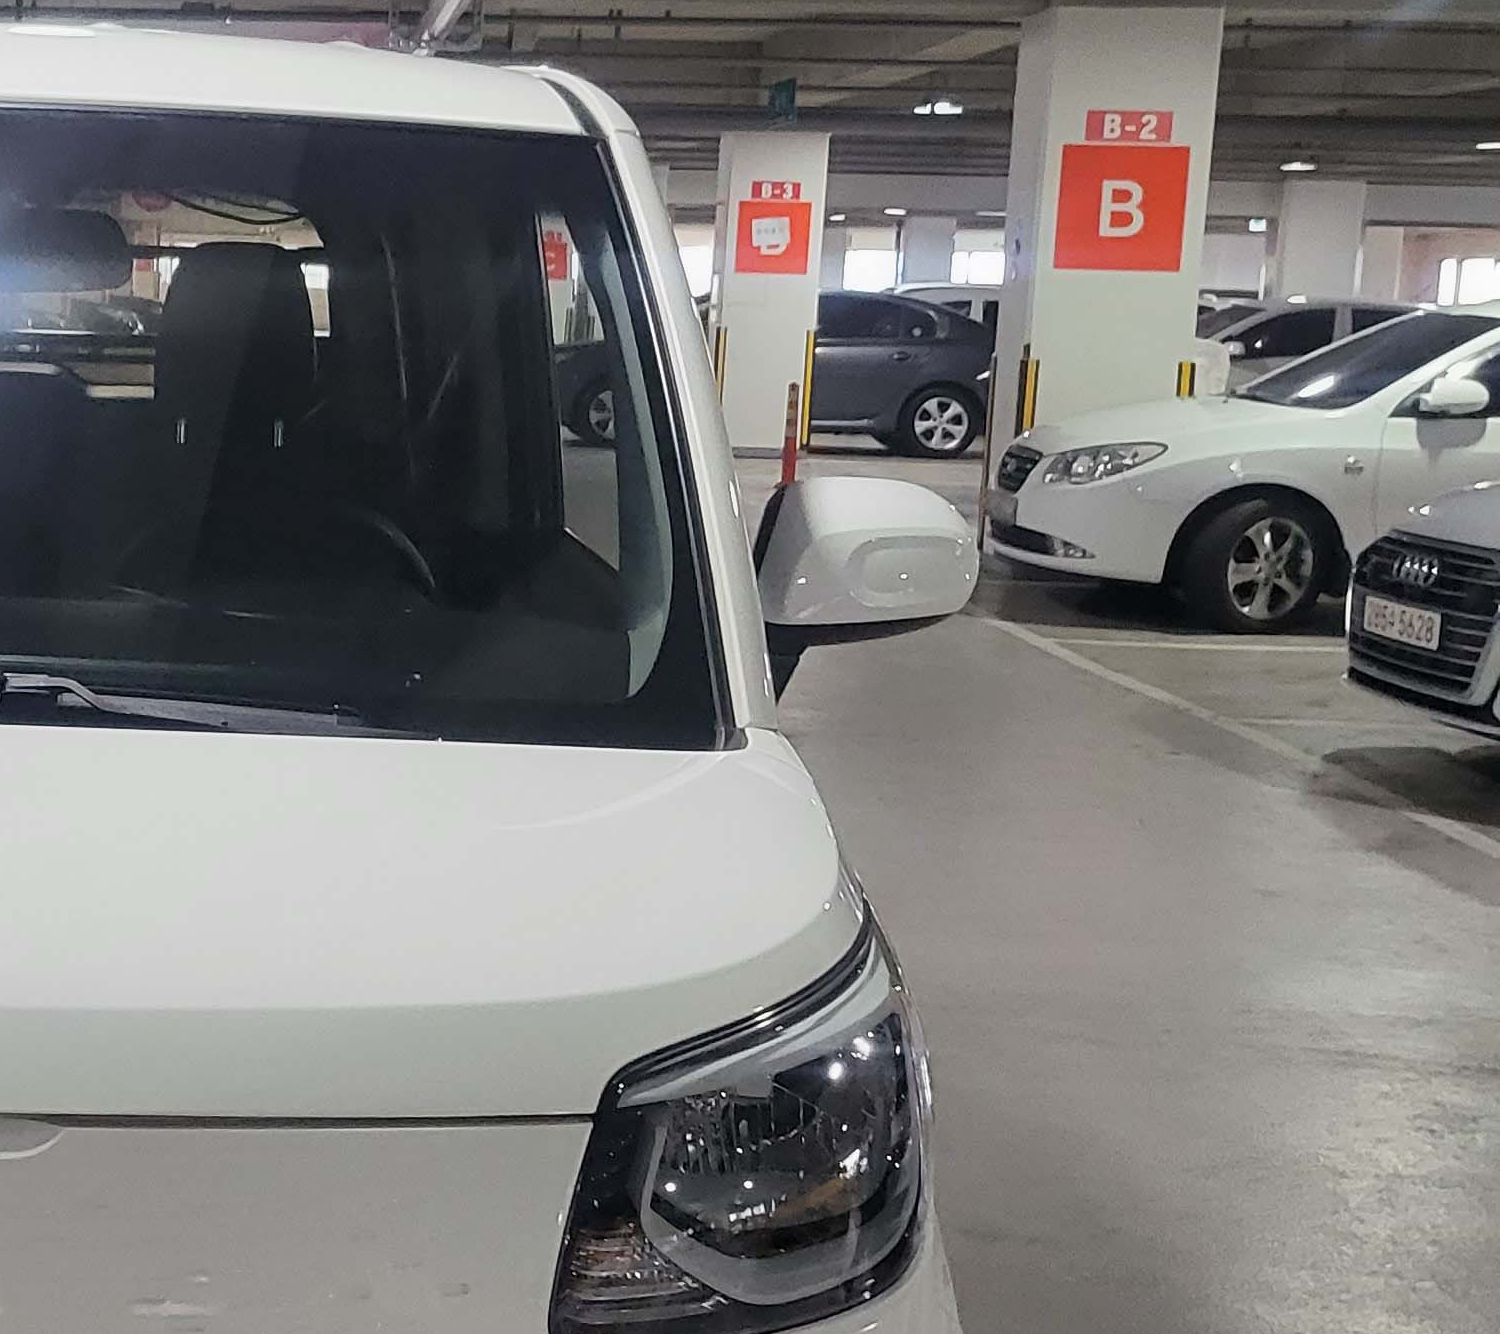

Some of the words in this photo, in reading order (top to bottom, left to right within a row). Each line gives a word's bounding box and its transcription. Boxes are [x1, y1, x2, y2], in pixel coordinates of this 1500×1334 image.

[1103, 113, 1158, 140] B-2
[761, 181, 794, 200] B-3
[1098, 179, 1145, 238] B
